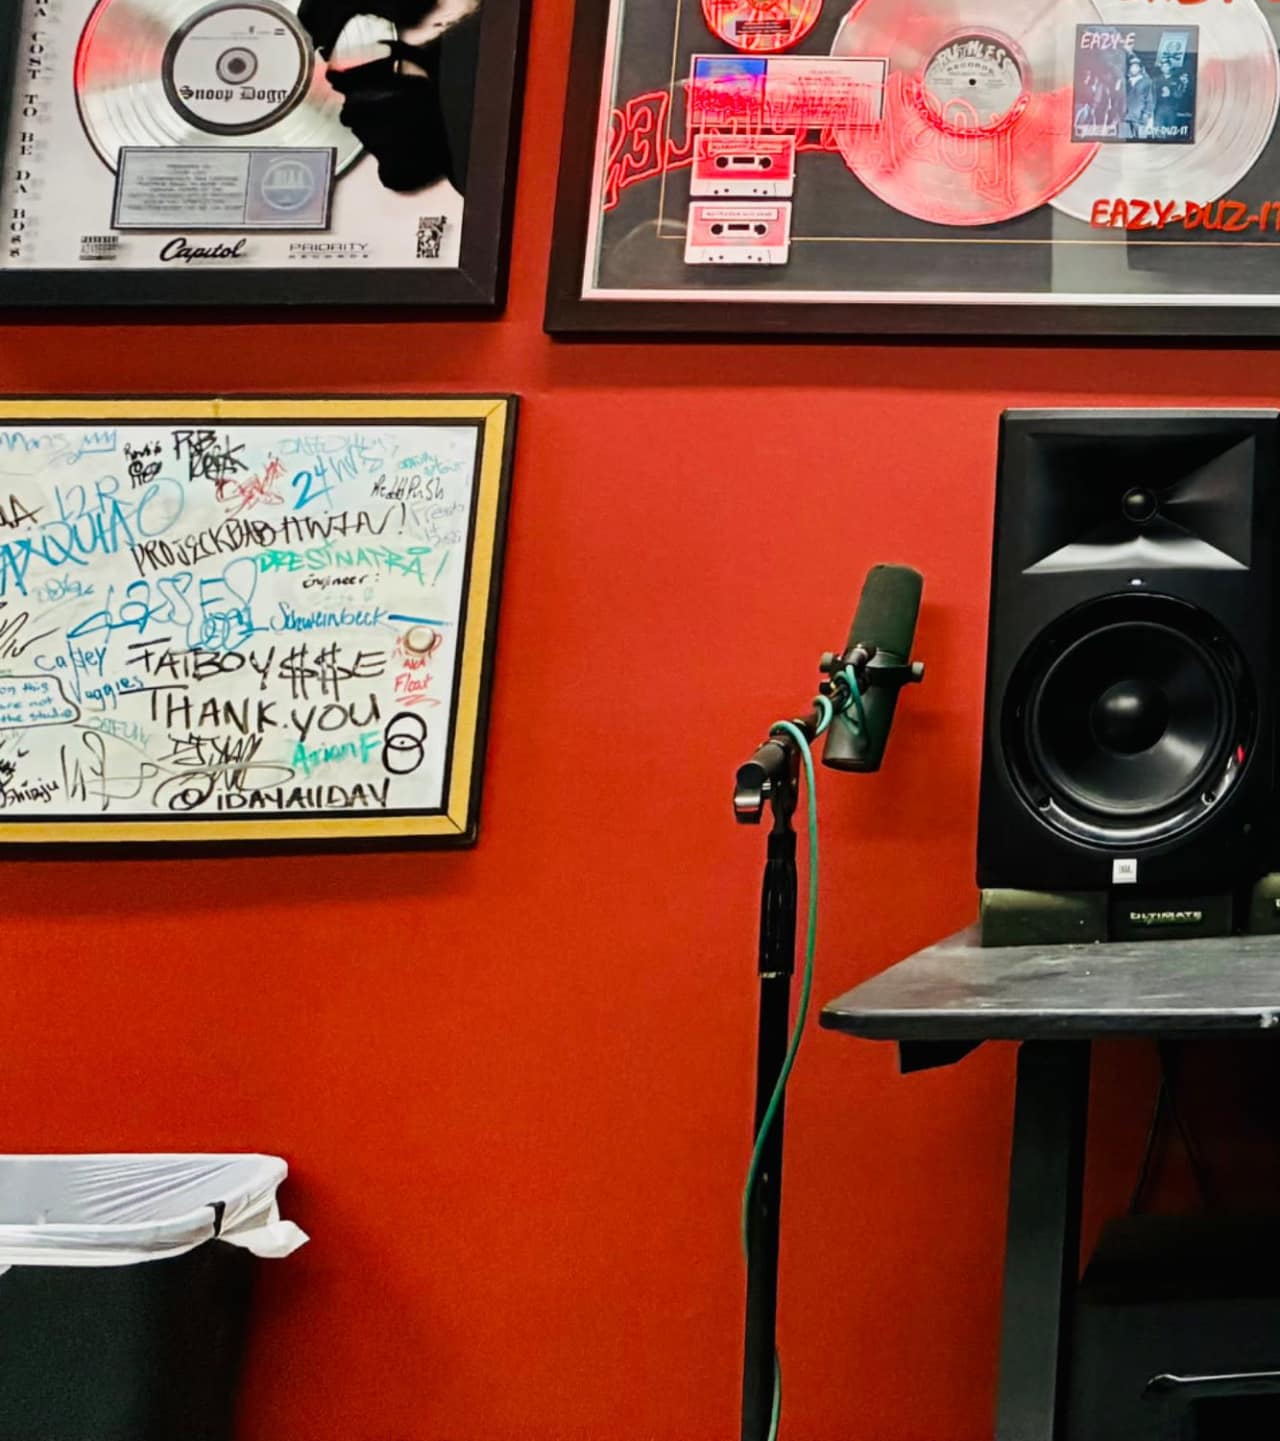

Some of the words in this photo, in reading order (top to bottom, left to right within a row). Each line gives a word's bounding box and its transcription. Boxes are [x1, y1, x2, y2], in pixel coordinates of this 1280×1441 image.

[1079, 30, 1136, 50] EAZY-E
[22, 93, 39, 118] TO
[179, 85, 234, 102] Snoop
[239, 85, 288, 104] Dogg
[19, 131, 36, 156] BE
[14, 169, 32, 195] DA
[159, 236, 248, 263] Capitol
[288, 242, 370, 253] PRIORITY
[1129, 910, 1203, 923] ULTIMATE
